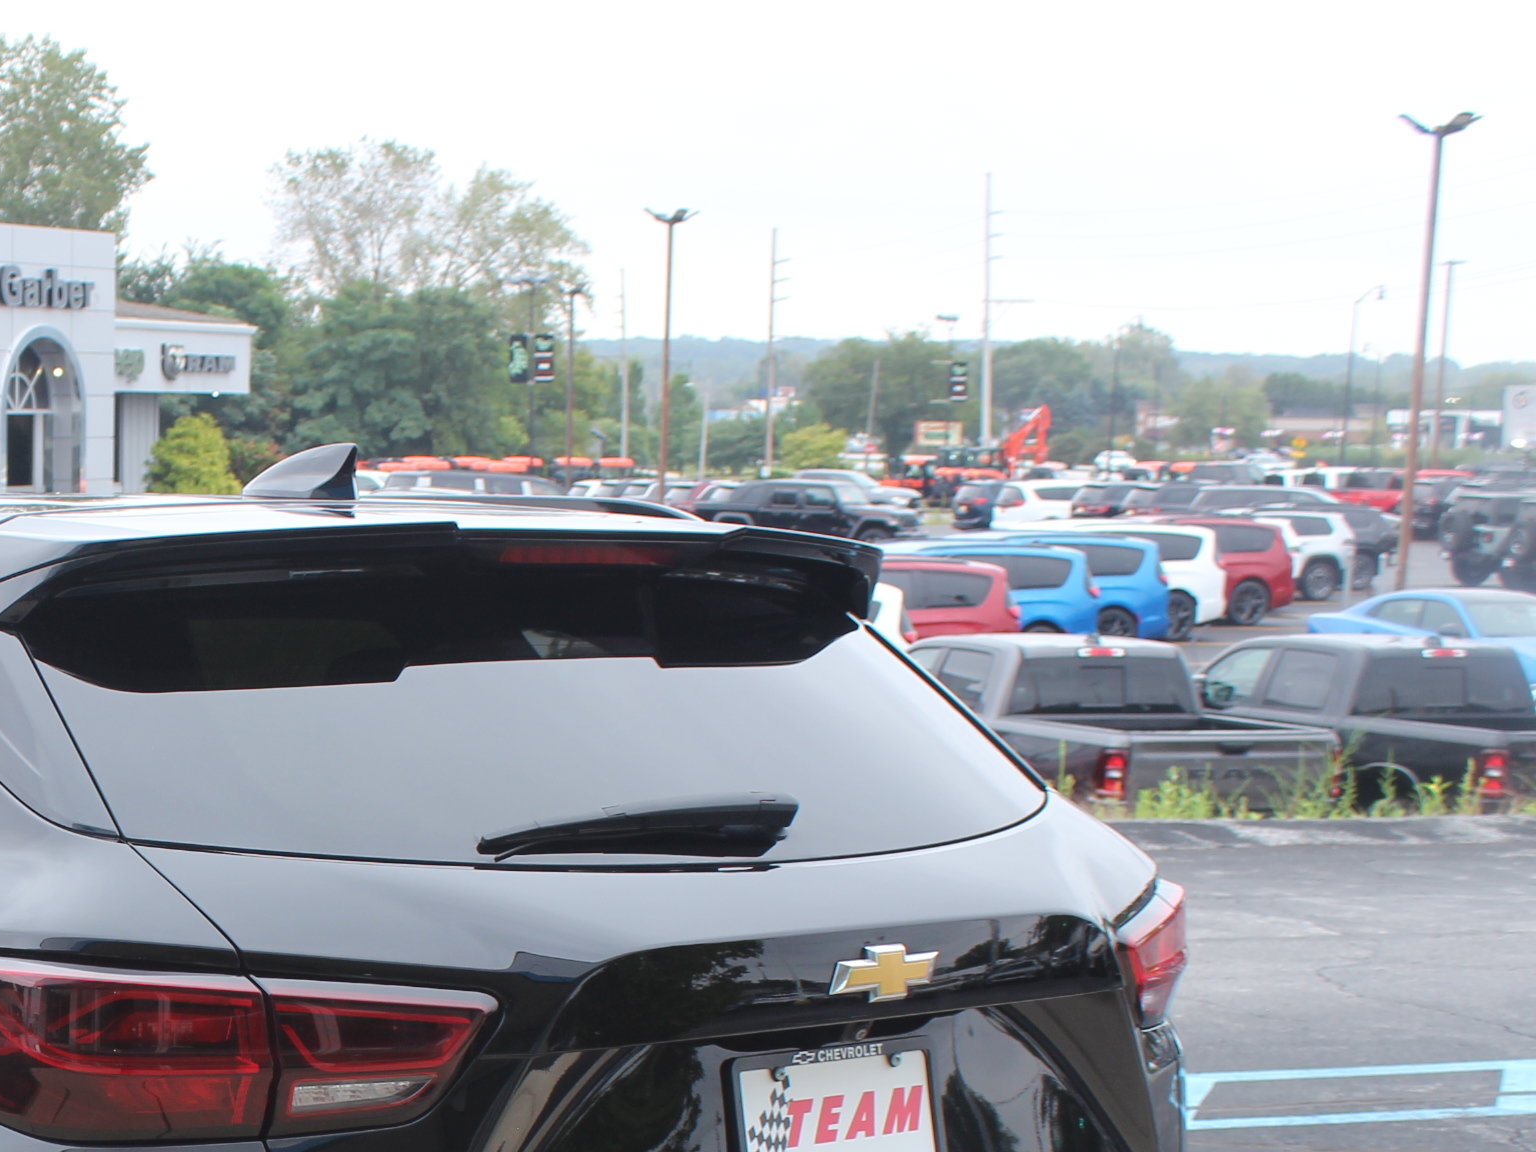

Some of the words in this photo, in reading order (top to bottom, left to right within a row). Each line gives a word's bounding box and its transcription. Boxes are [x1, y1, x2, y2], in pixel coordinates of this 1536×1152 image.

[184, 353, 237, 375] RAM
[816, 1043, 884, 1062] CHEVROLET
[786, 1085, 923, 1148] TEAM
